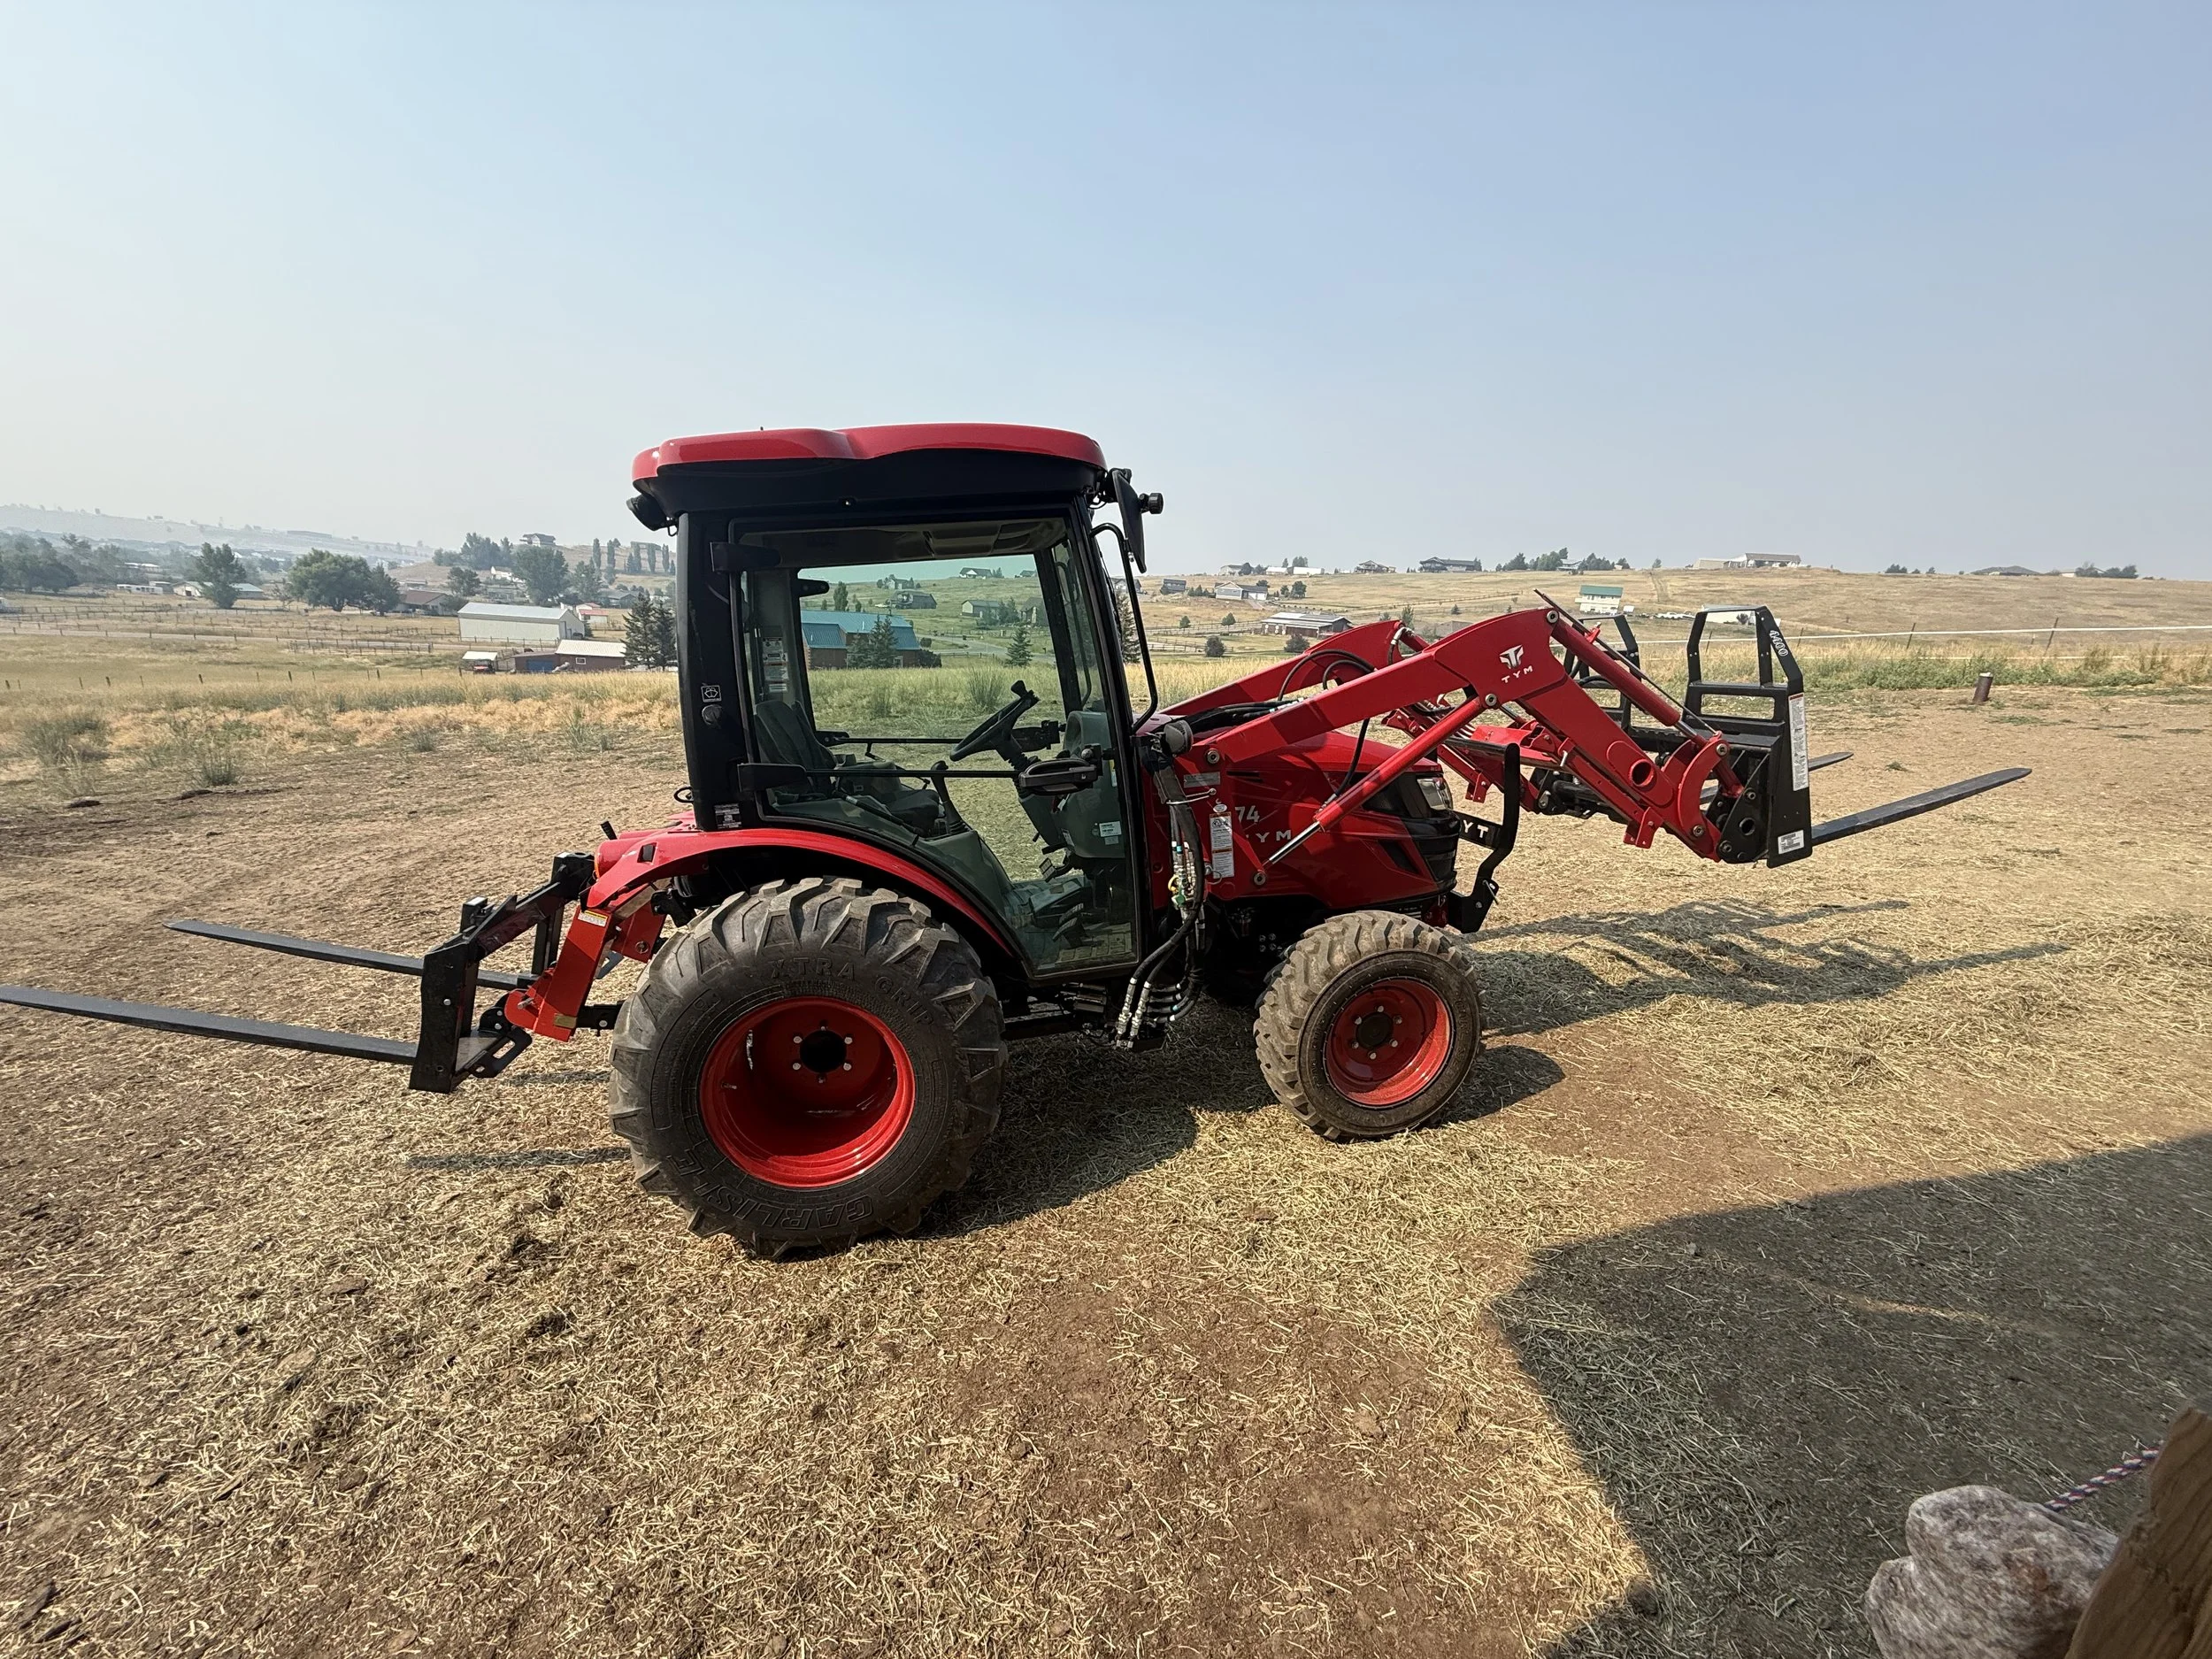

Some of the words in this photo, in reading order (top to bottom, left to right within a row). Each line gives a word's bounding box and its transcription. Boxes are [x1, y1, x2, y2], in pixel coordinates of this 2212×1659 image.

[1502, 665, 1533, 683] TYM
[1234, 805, 1260, 823] 74
[1246, 829, 1292, 843] YM
[666, 1148, 874, 1230] CARLISLE
